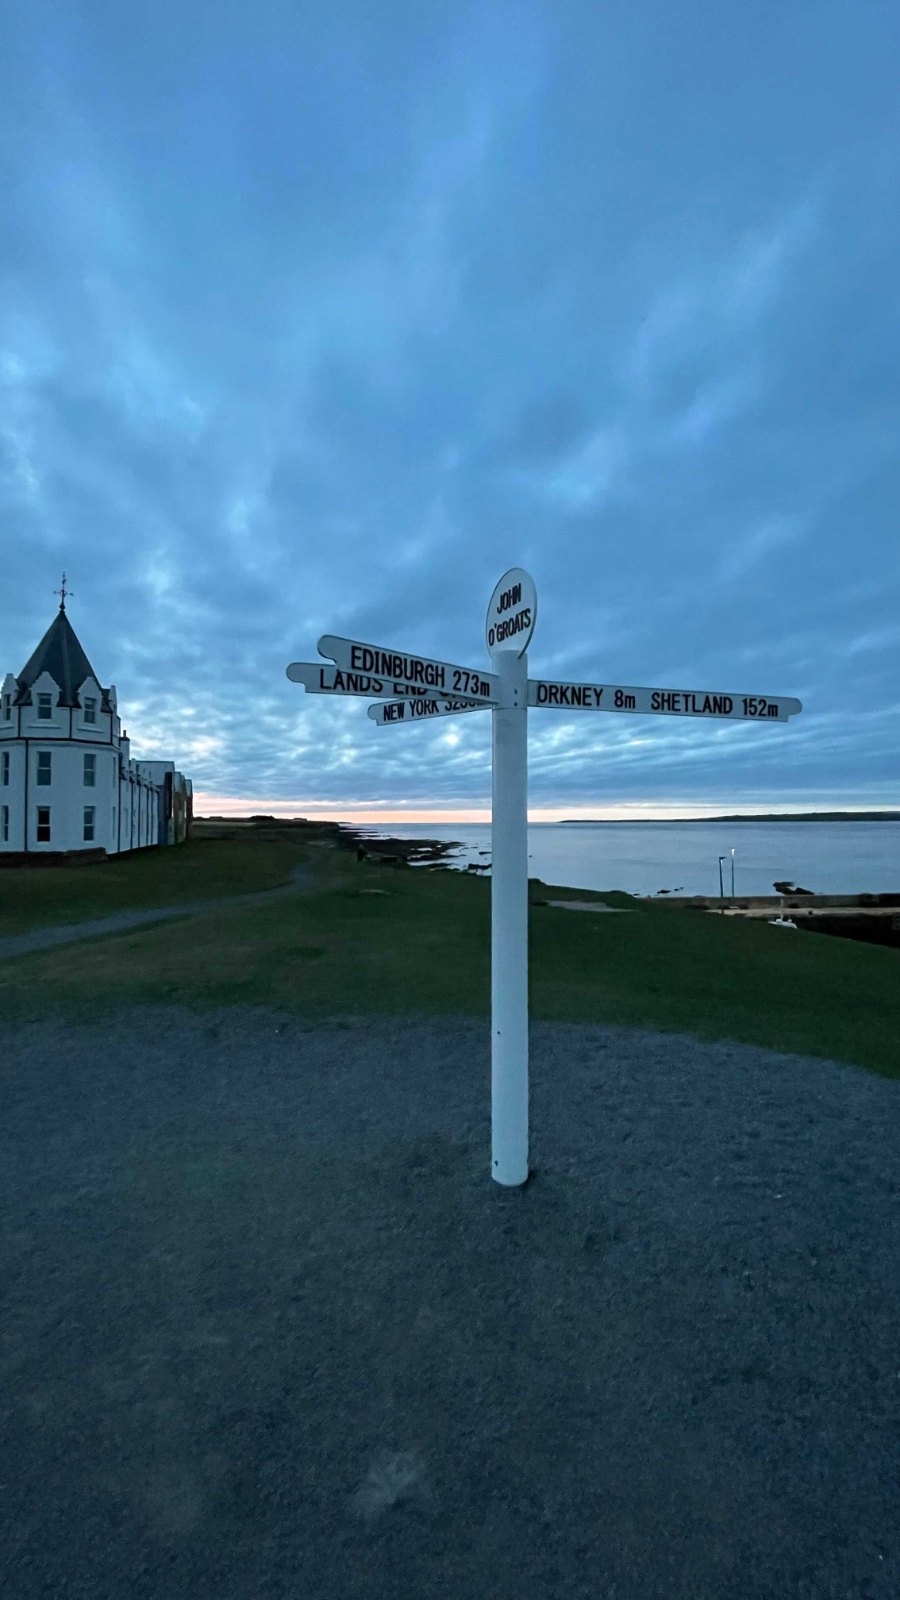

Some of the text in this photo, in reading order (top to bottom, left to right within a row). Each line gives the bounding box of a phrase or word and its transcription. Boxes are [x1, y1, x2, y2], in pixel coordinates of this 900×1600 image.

[497, 583, 522, 614] JOHN
[488, 608, 531, 647] O'GROATS
[320, 668, 383, 693] LANDS
[351, 645, 490, 697] EDINBURGH 273m
[383, 702, 405, 722] NEW
[409, 699, 439, 717] YORK
[537, 684, 779, 718] ORKNEY 8m SHETLAND 152m
